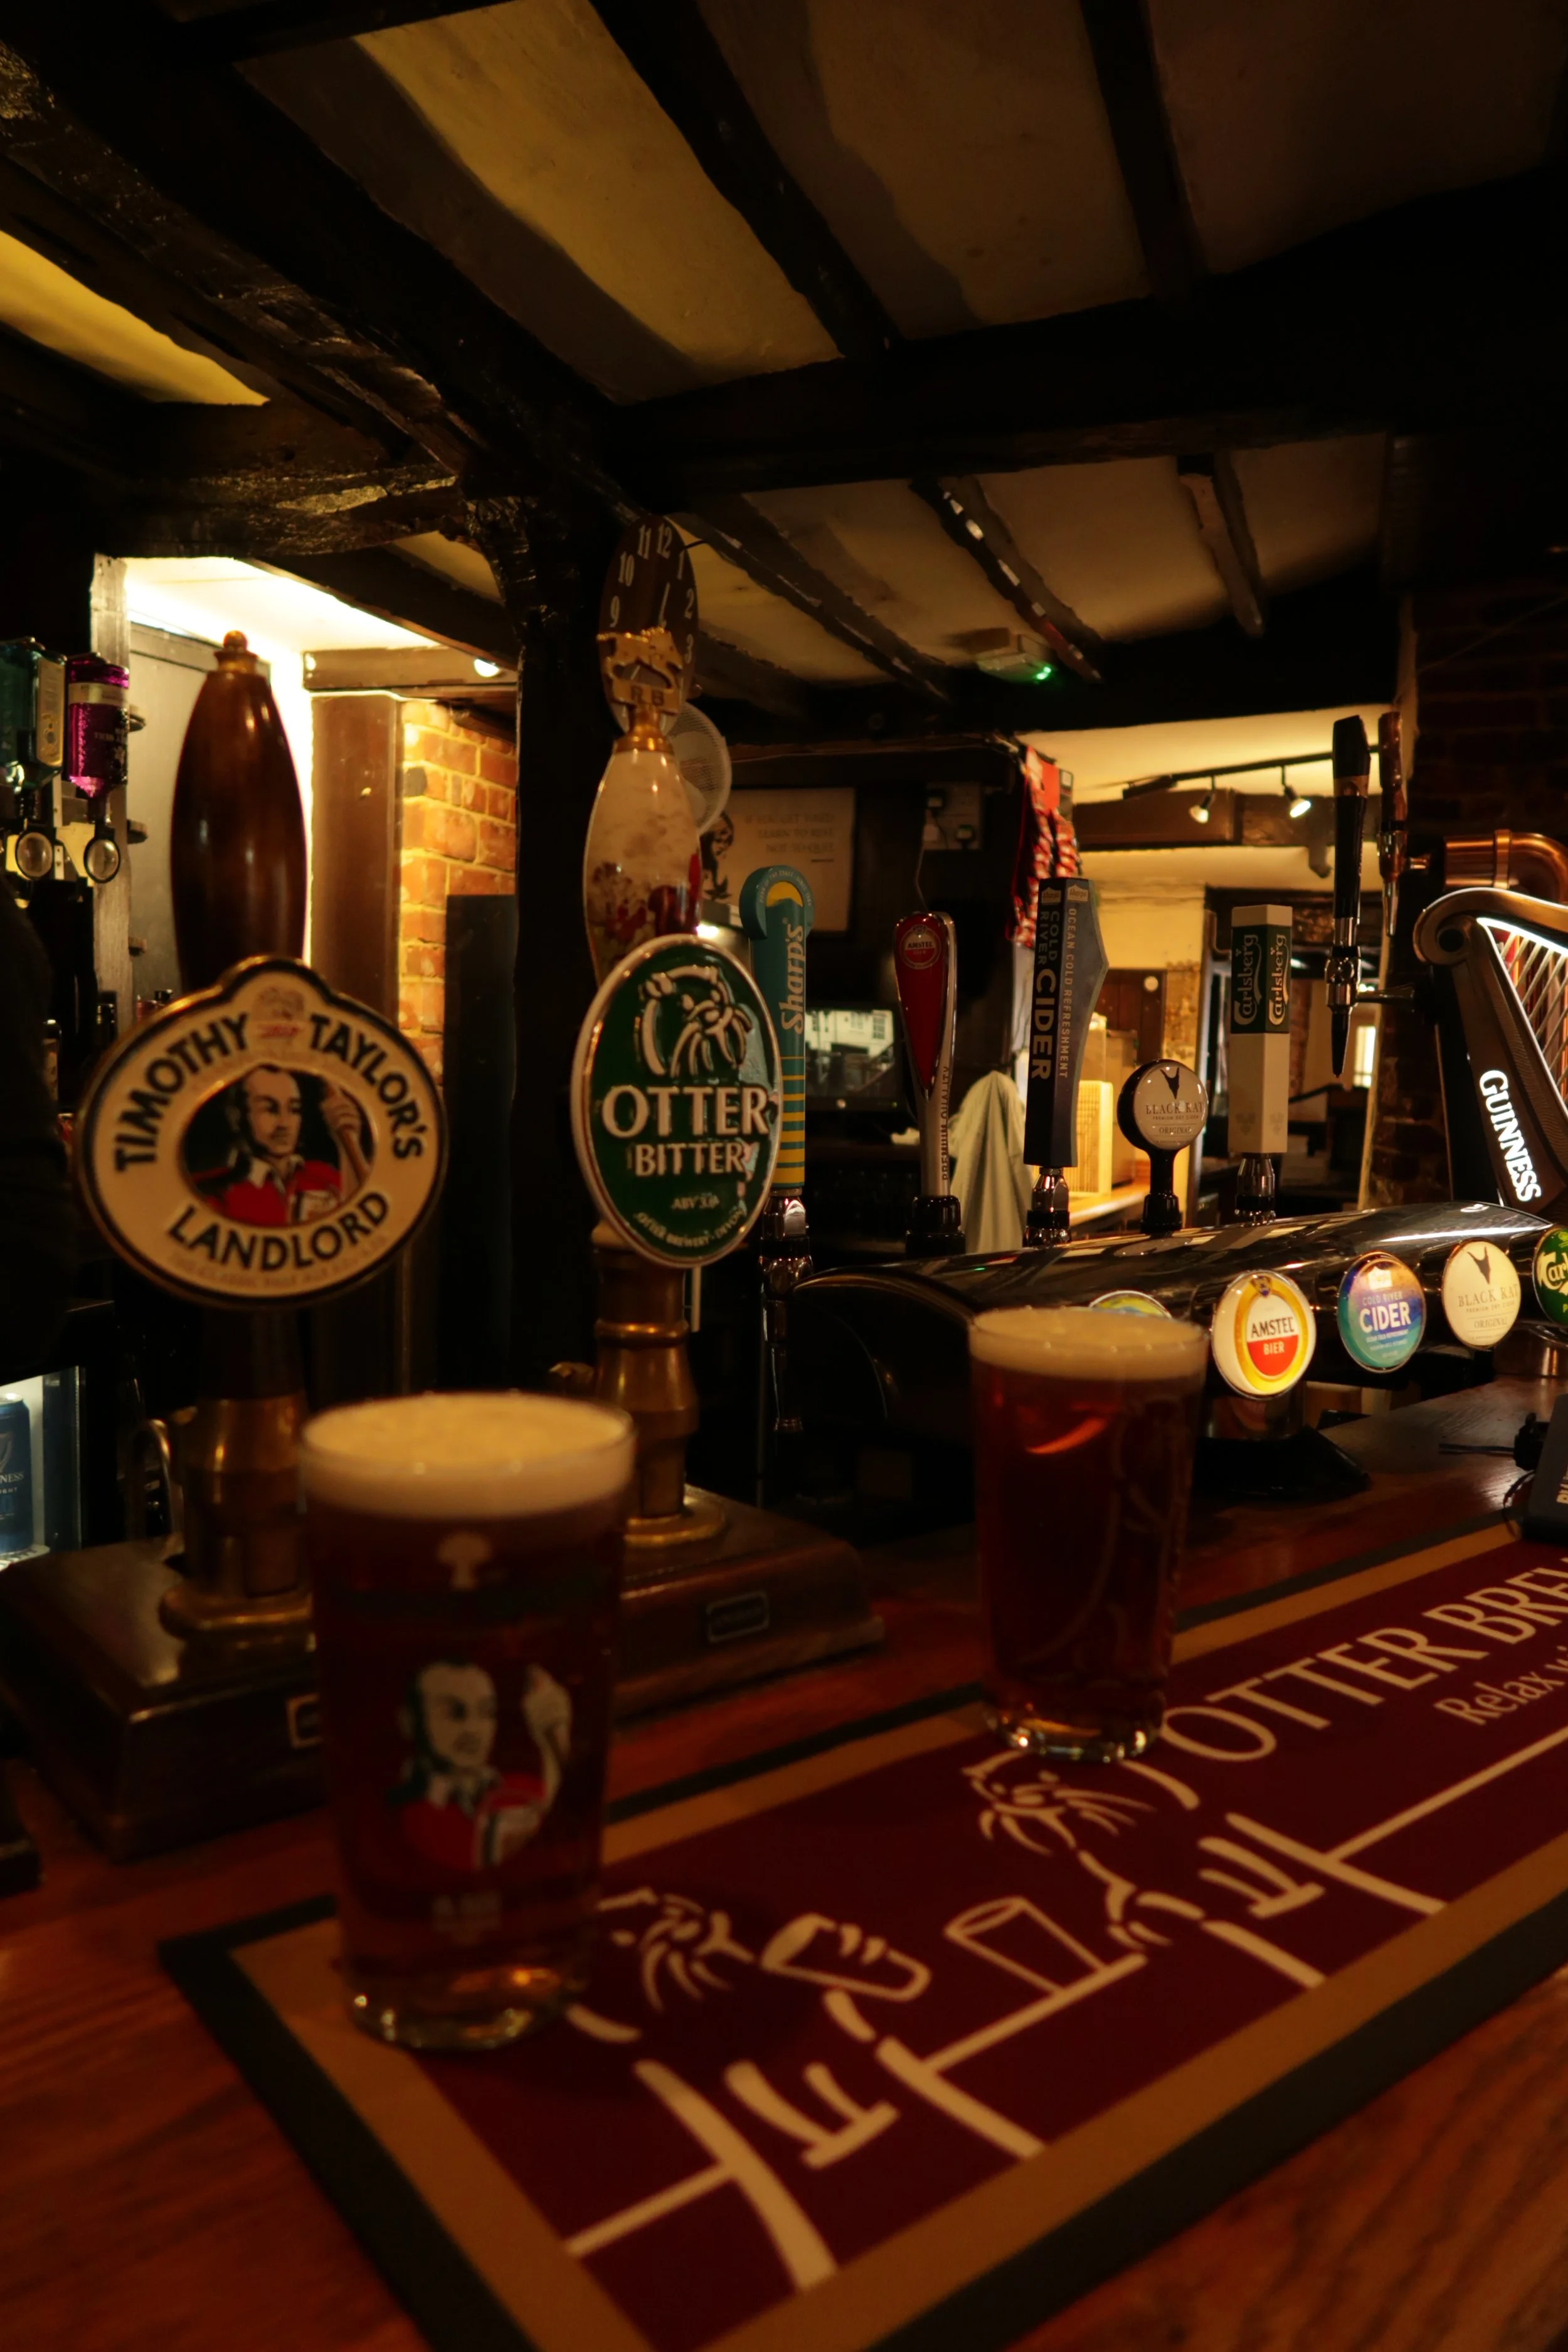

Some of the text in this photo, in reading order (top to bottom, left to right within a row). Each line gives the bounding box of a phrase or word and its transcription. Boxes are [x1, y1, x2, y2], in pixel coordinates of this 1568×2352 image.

[637, 524, 652, 560] 11
[656, 522, 672, 559] 12
[618, 551, 635, 588] 10
[610, 595, 620, 628] 9
[684, 588, 694, 620] 2
[1037, 911, 1049, 965] RIVER
[1048, 911, 1060, 961] COLD
[778, 924, 806, 1034] Sharp's
[1059, 908, 1077, 1078] OCEAN COLD REFRESHMENT
[1234, 934, 1259, 1025] Carlsberg
[1268, 933, 1286, 1025] Carlsberg
[1030, 968, 1056, 1080] CIDER
[115, 1013, 428, 1173] TIMOTHY TAYLOR'S
[601, 1084, 770, 1140] OTTER
[1145, 1103, 1181, 1115] BLACK
[635, 1142, 746, 1177] BITTER
[1479, 1069, 1542, 1202] GUINNESS
[167, 1192, 389, 1271] LANDLORD
[1359, 1301, 1411, 1333] CIDER
[1362, 1291, 1403, 1306] COLD RIVER
[1458, 1288, 1496, 1307] BLACK
[1251, 1316, 1295, 1338] AMSTEL
[1263, 1341, 1285, 1355] BIER
[1160, 1626, 1490, 1762] OTTER
[1433, 1671, 1566, 1727] Relax
